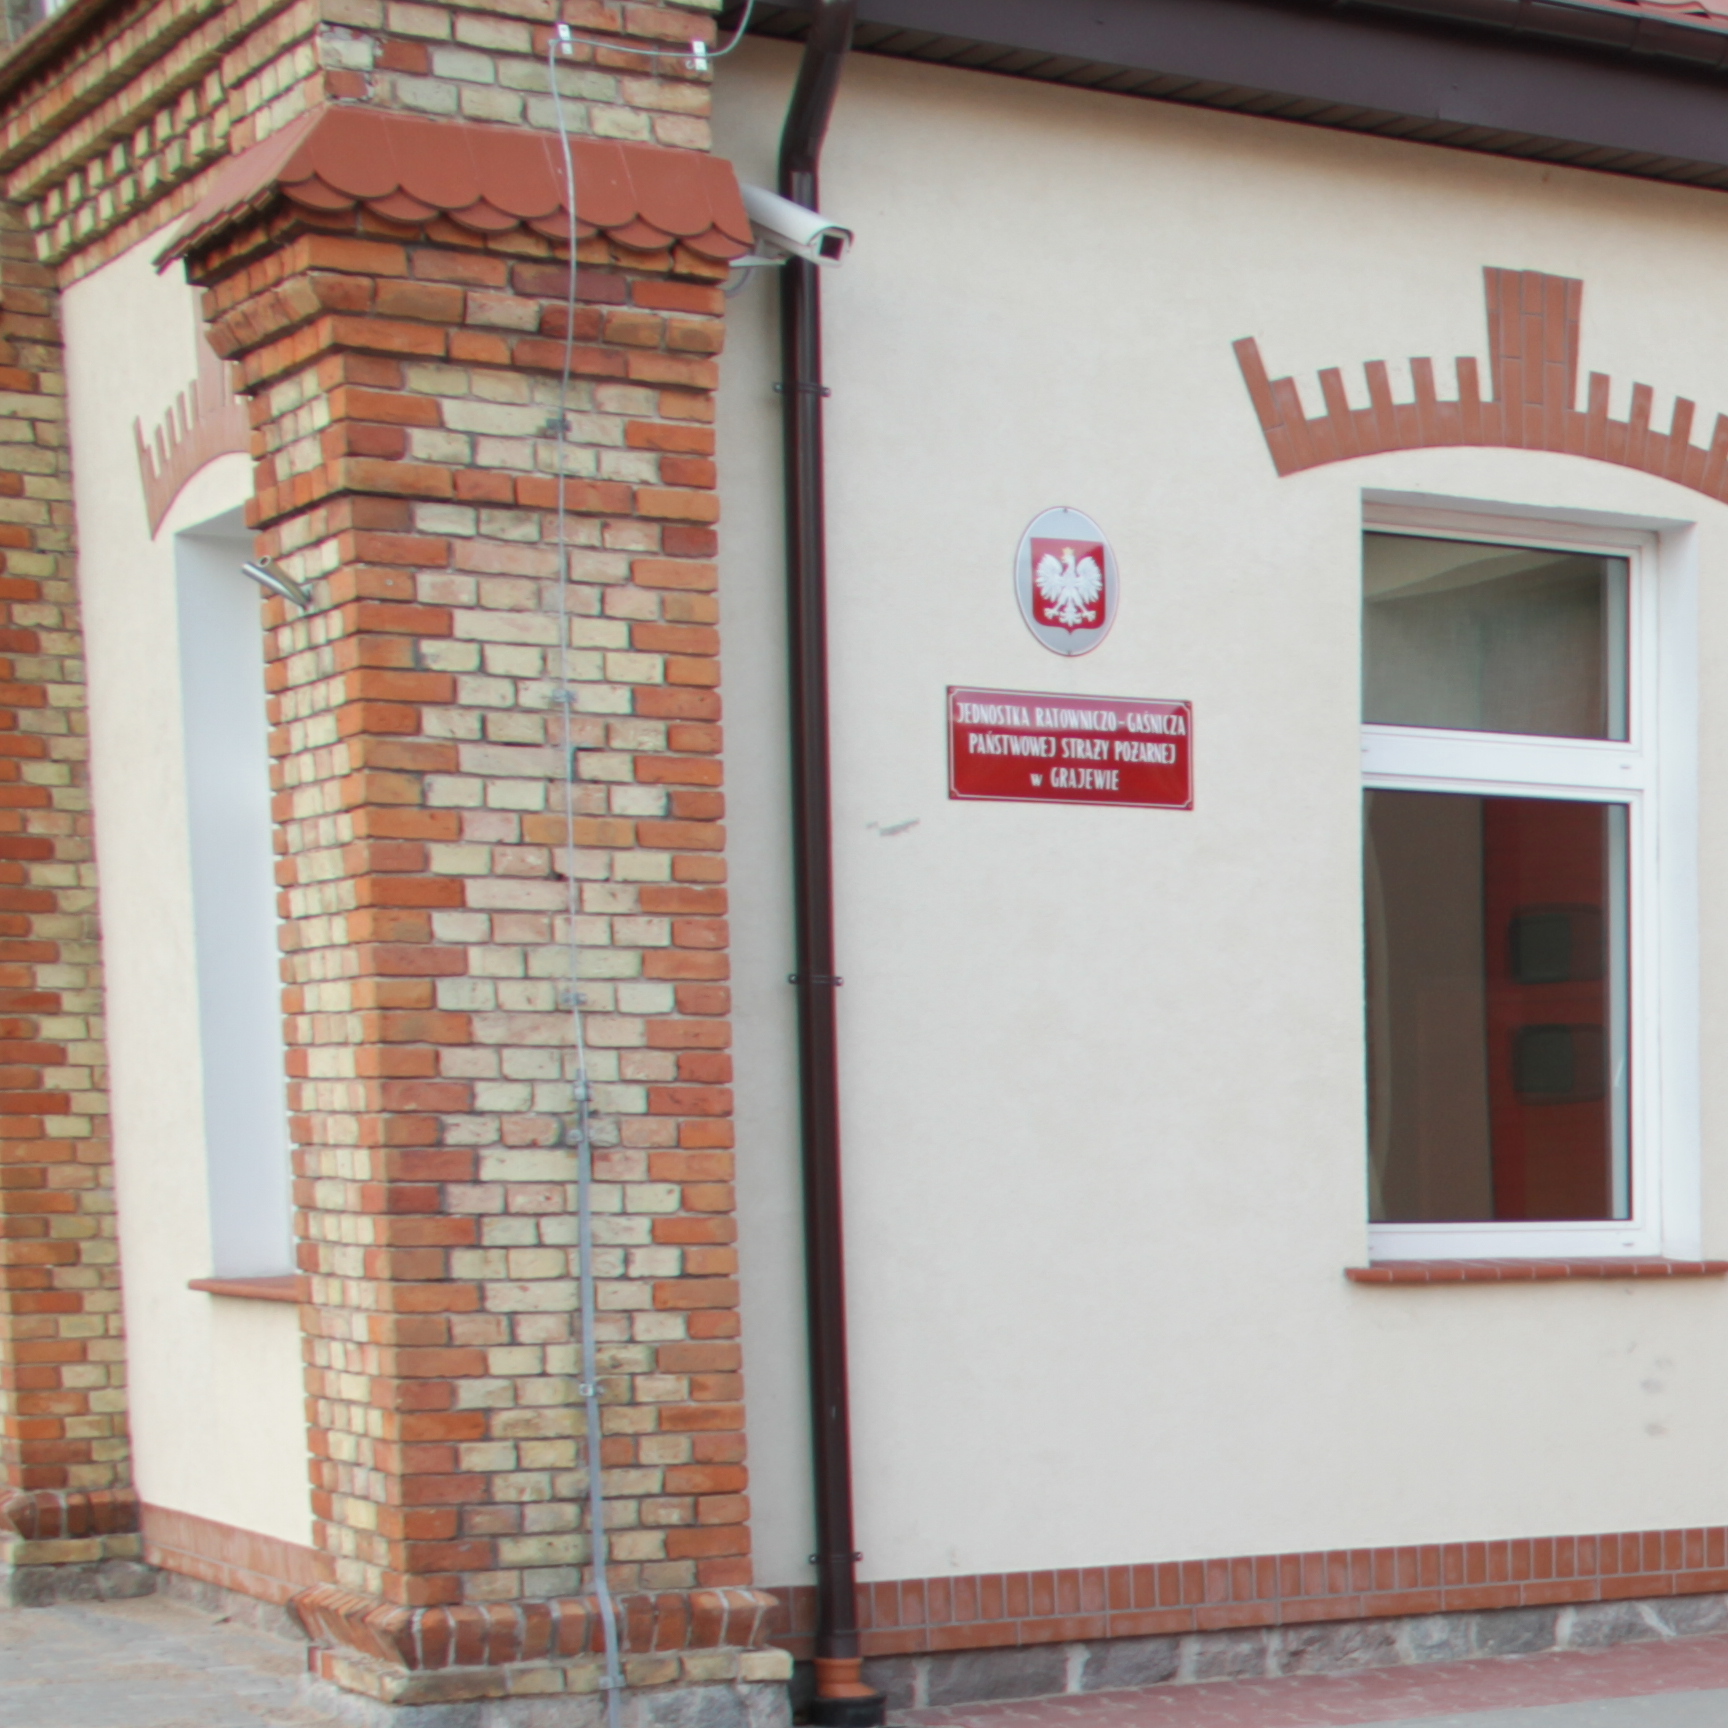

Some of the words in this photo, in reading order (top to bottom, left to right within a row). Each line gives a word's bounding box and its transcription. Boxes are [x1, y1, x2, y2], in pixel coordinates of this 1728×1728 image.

[956, 702, 1031, 727] JEDNOSTKA
[968, 730, 1057, 758] PAŃSTWOWEJ
[1030, 773, 1043, 787] w
[1050, 766, 1120, 791] GRAJEWIE
